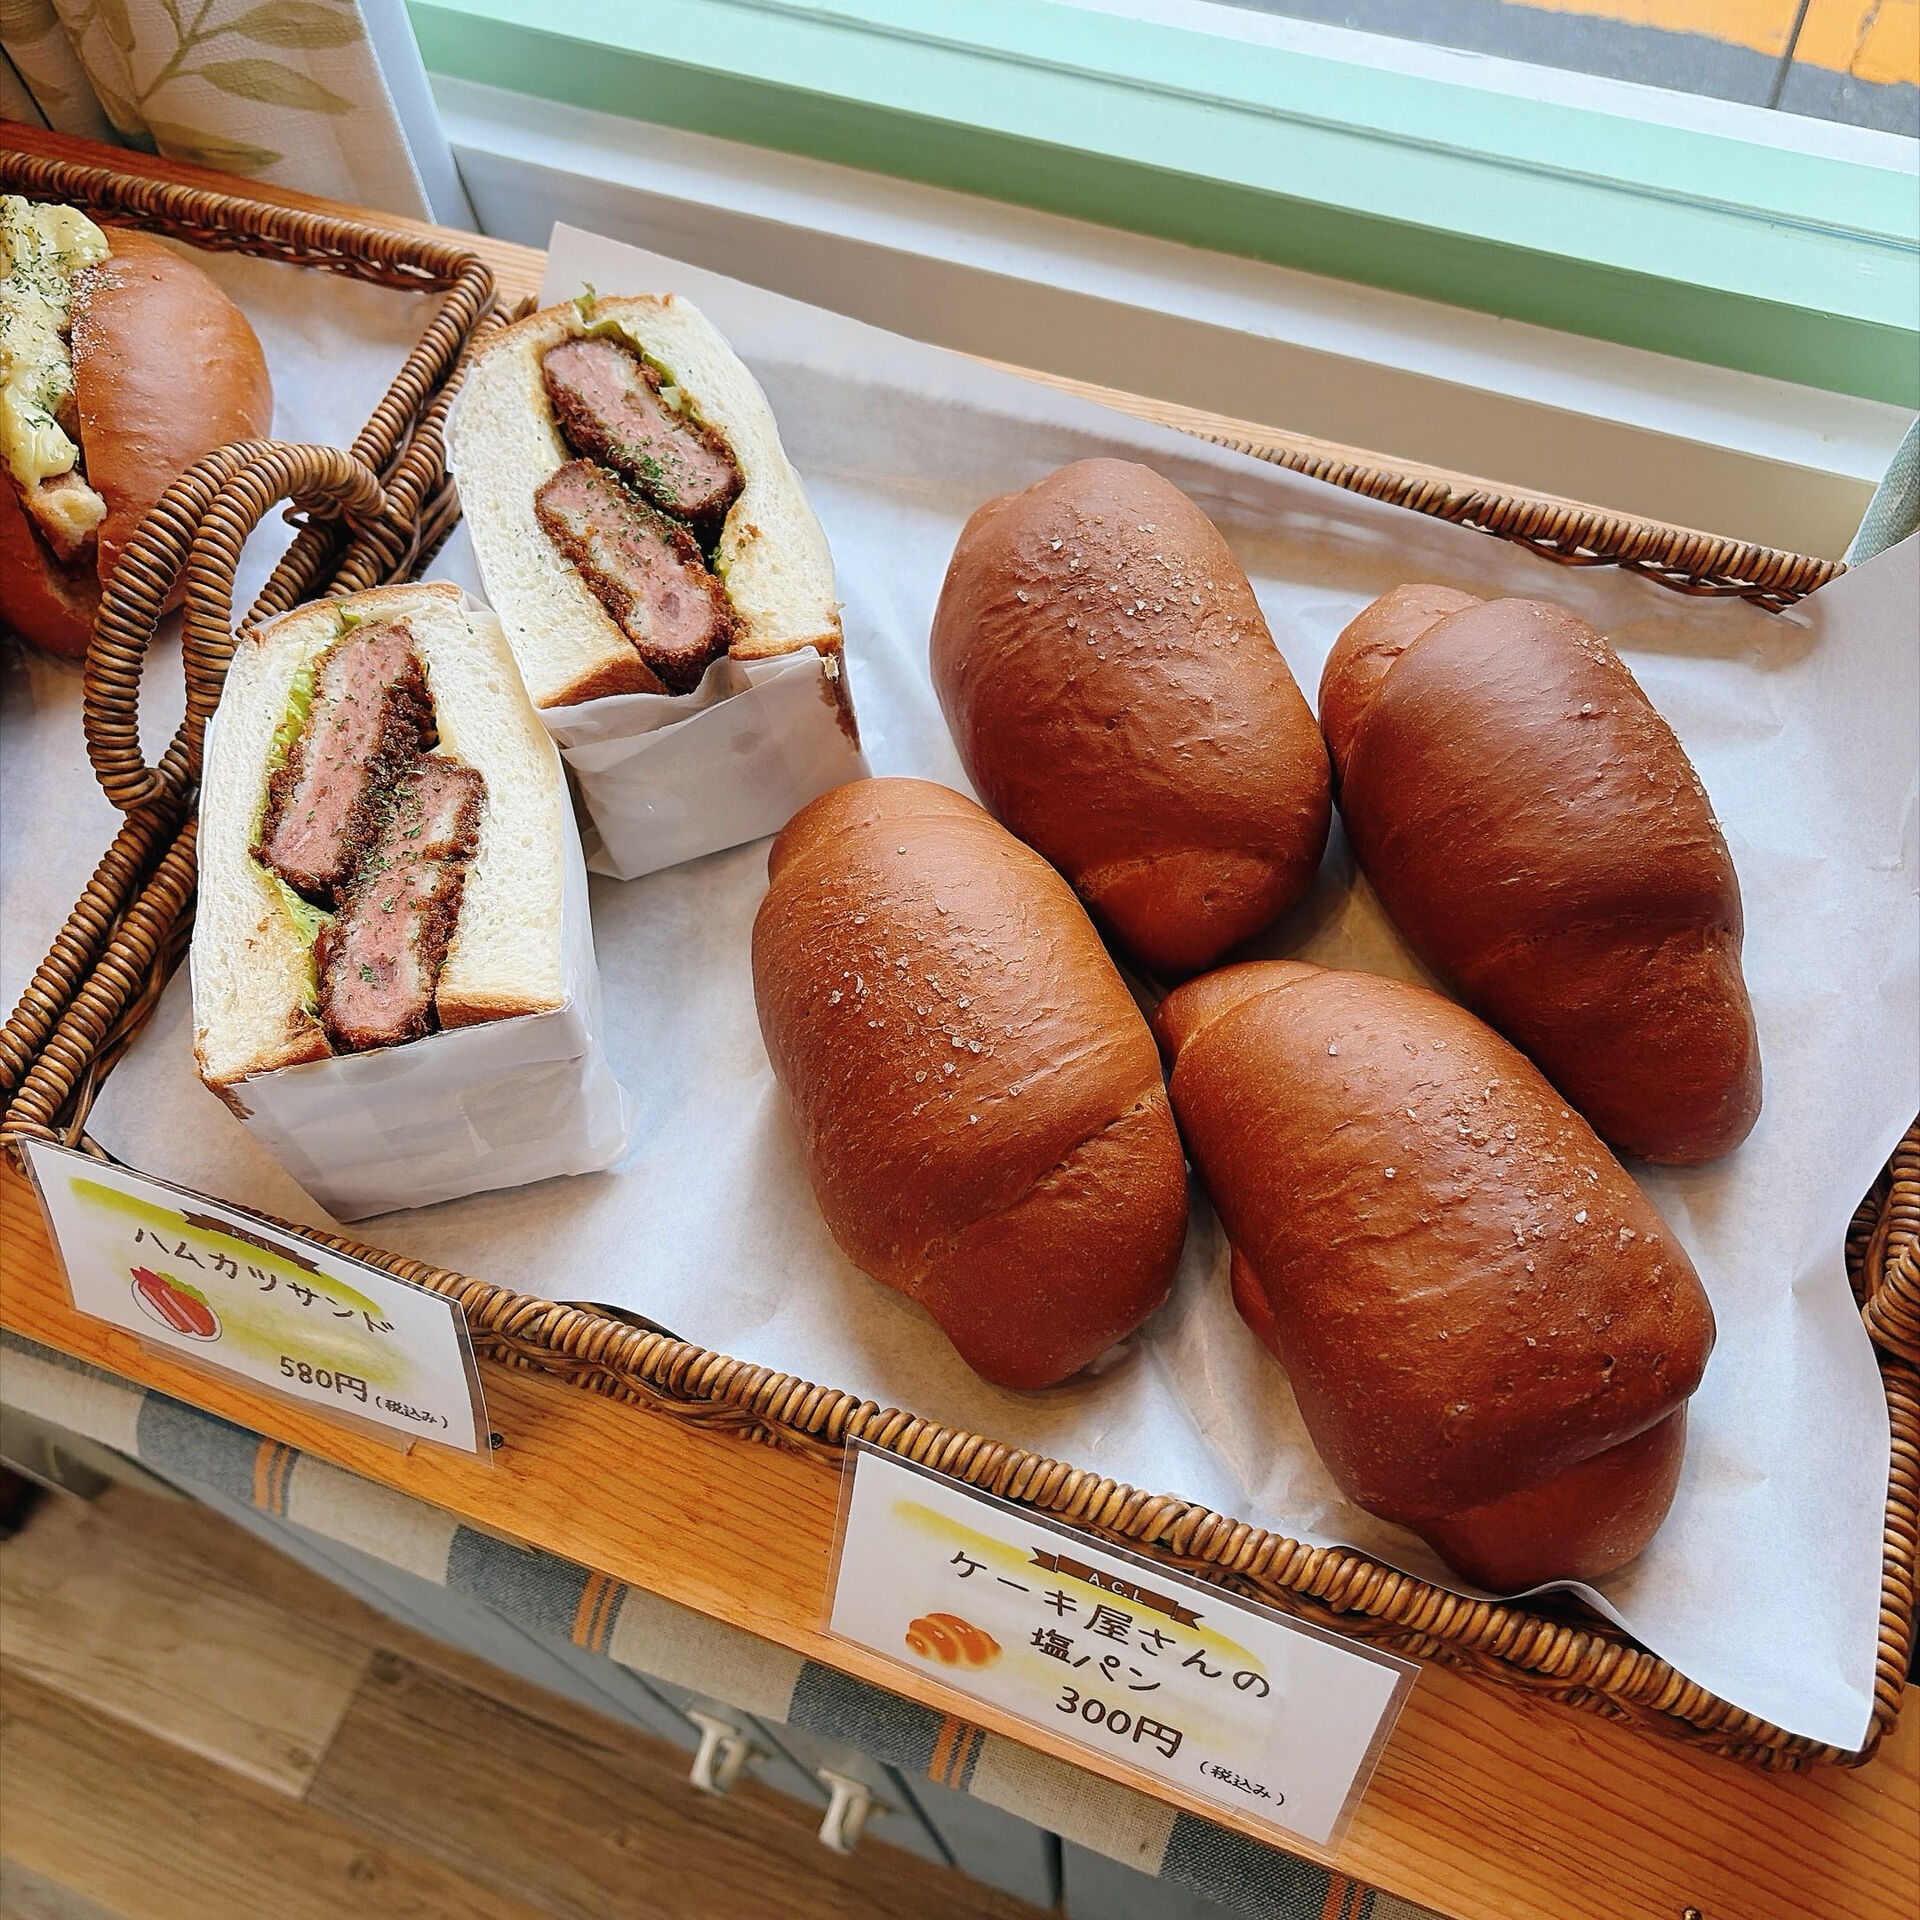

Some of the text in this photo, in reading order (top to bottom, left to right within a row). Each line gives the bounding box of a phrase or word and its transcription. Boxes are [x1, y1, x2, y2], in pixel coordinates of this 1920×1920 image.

[134, 1227, 395, 1334] ハムカツサンド
[280, 1355, 369, 1403] 580円
[1088, 1572, 1144, 1603] A.C.L
[950, 1550, 1271, 1698] ケーキ屋さんの
[1031, 1627, 1162, 1692] 塩パン
[1055, 1686, 1184, 1759] 300円
